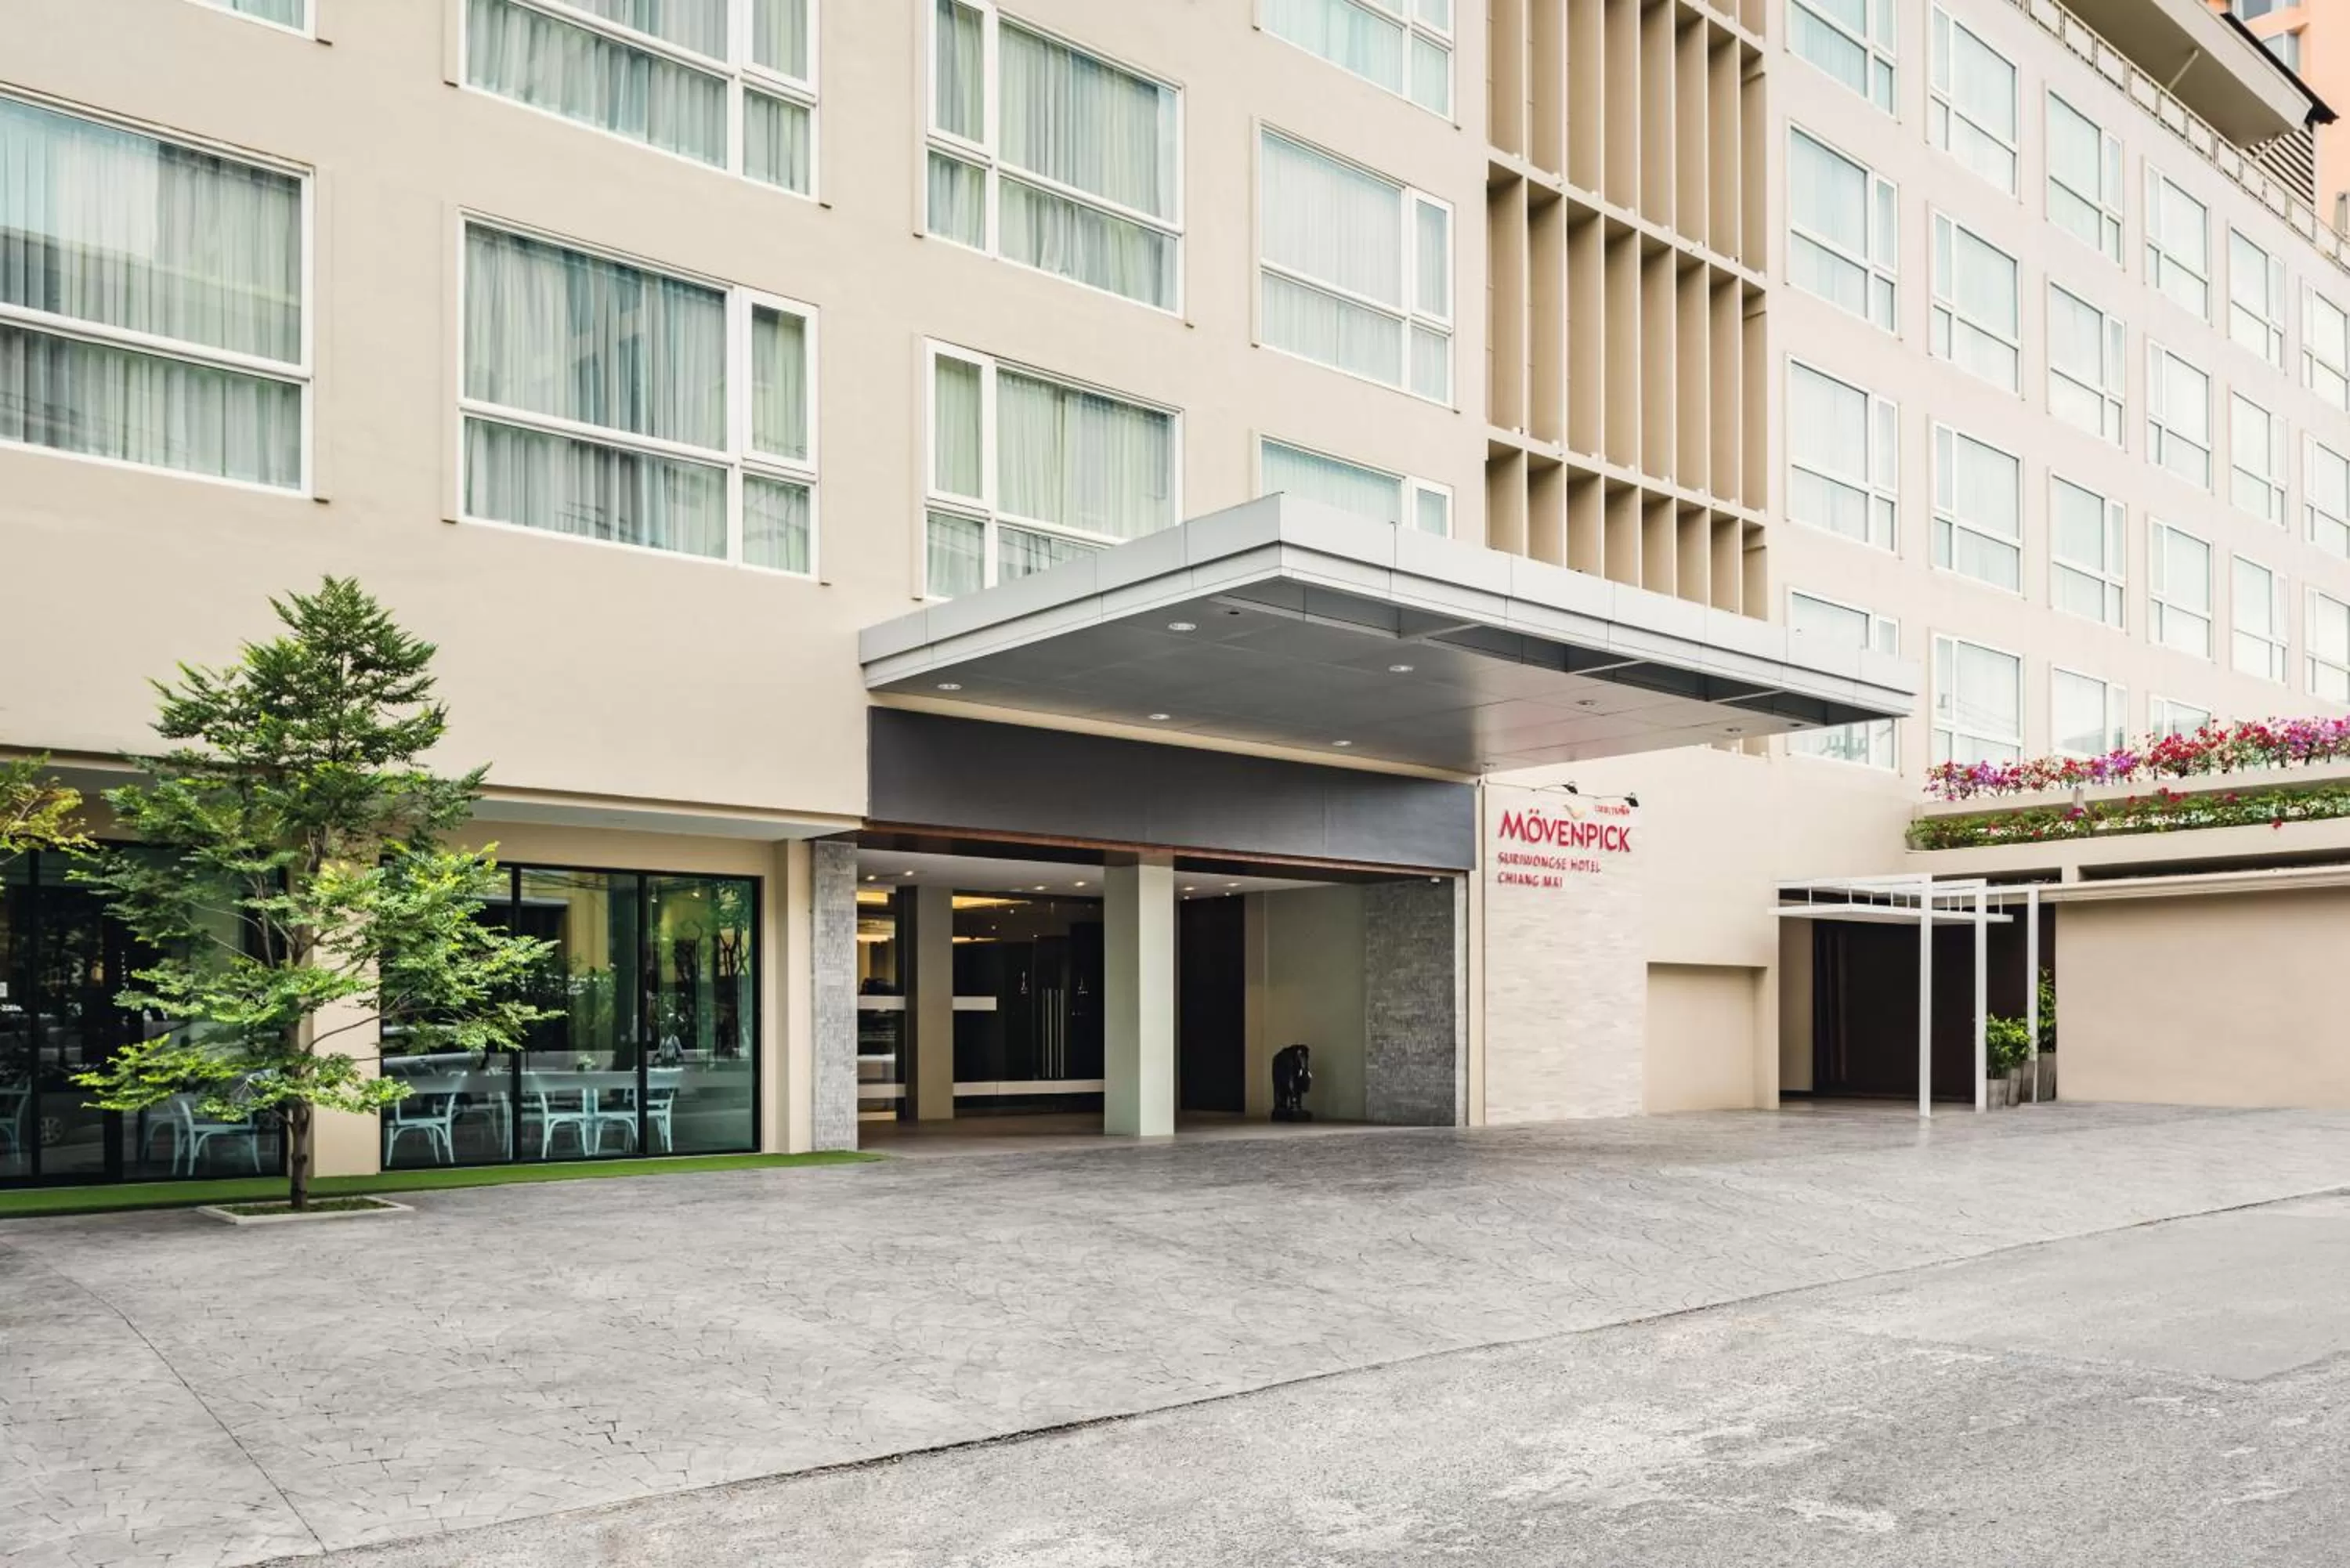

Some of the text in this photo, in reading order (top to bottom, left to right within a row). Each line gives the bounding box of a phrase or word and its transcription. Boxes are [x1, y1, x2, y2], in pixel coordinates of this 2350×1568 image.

[1499, 808, 1630, 852] MÖVENPICK
[1498, 852, 1601, 873] SURIWONGSE HOTEL
[1498, 872, 1563, 887] CHIANG MAI
